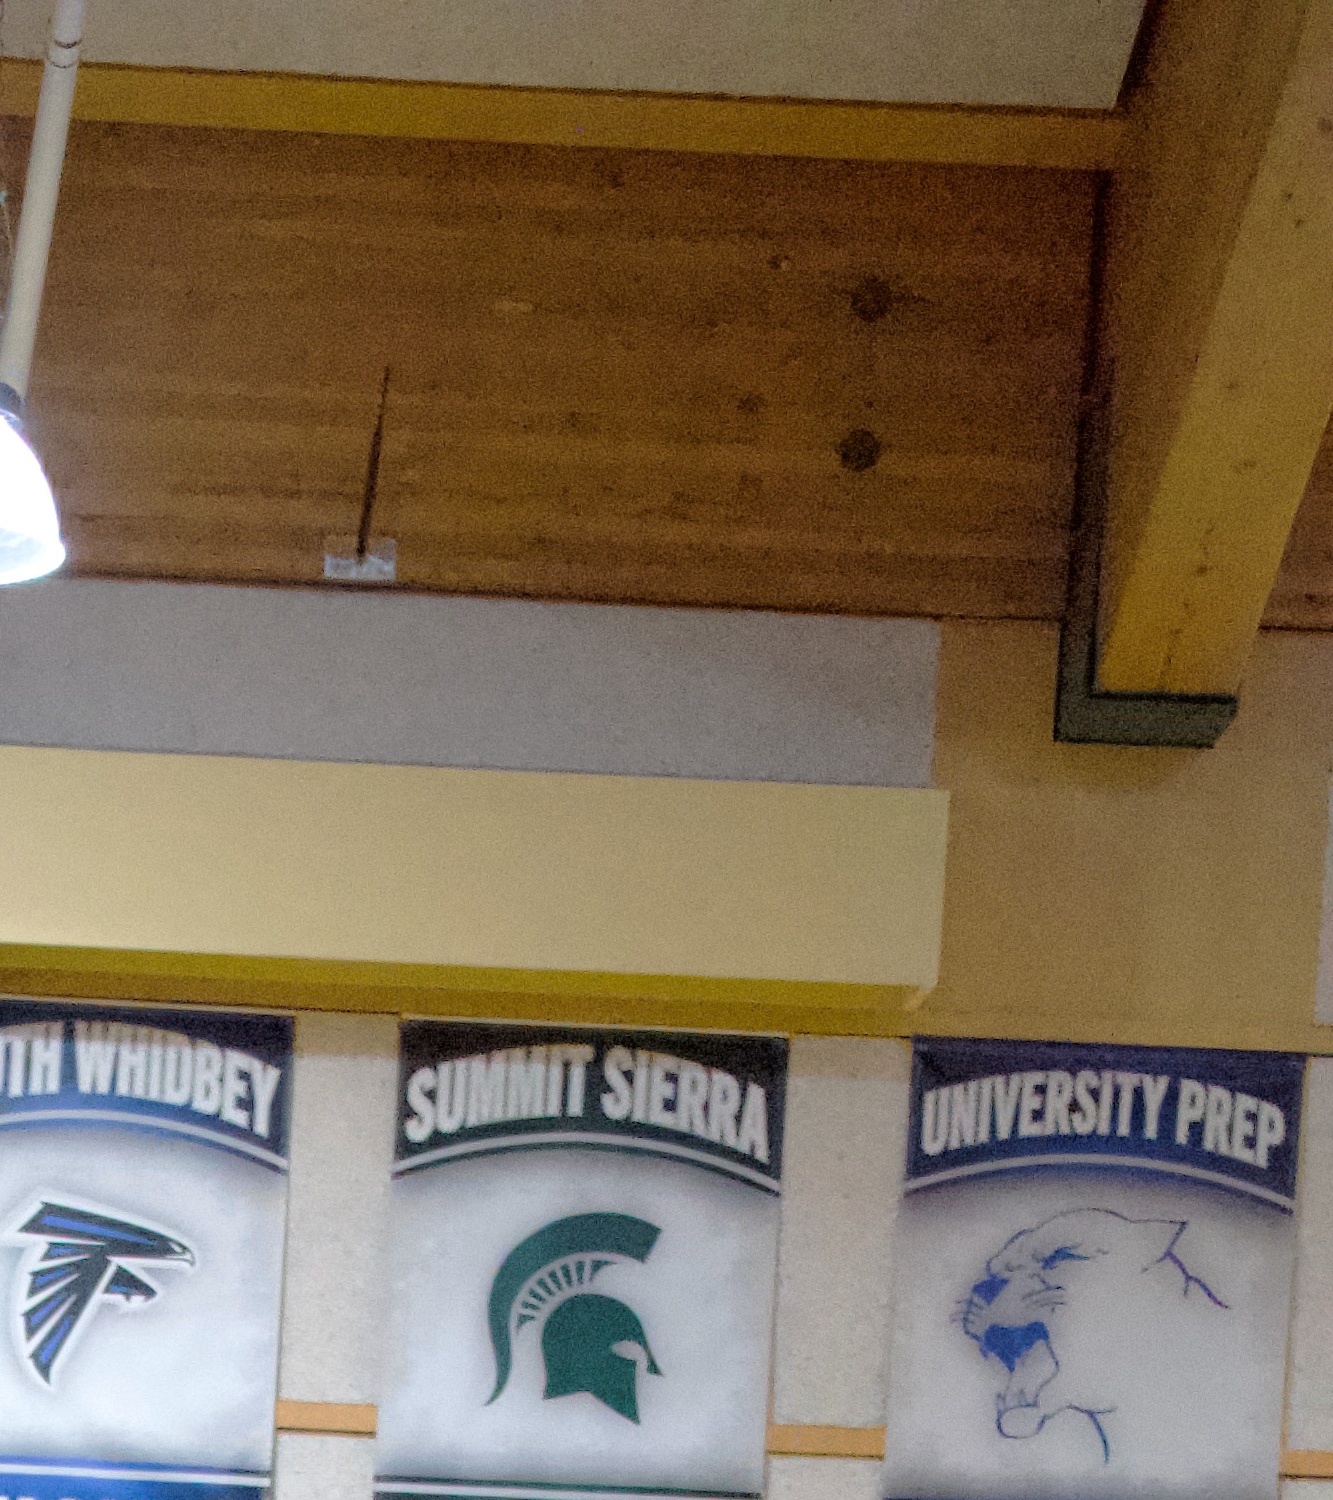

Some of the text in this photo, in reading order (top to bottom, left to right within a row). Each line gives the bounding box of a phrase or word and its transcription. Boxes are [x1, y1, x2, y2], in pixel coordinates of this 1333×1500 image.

[75, 1018, 281, 1141] WHIDBEY
[404, 1042, 770, 1166] SUMMIT SIERRA
[920, 1070, 1287, 1173] UNIVERSITY PREP
